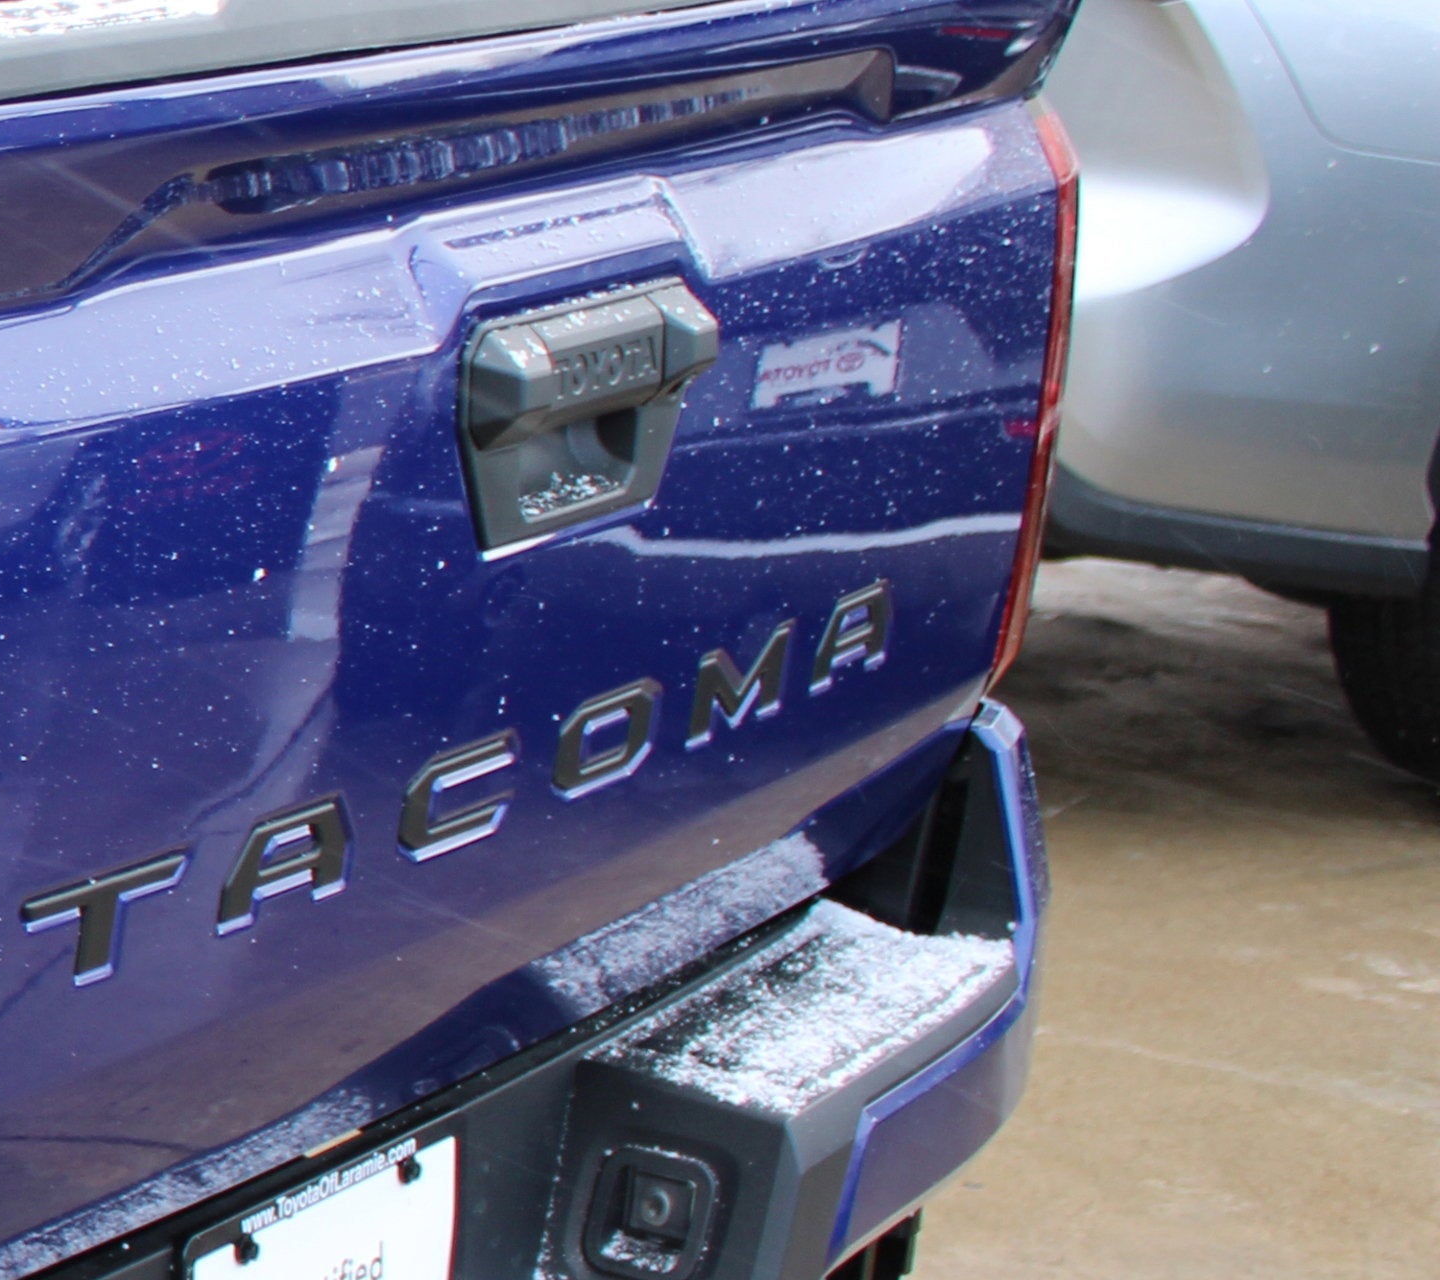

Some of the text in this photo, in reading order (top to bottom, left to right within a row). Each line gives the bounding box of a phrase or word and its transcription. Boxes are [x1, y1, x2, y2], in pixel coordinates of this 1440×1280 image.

[555, 335, 658, 400] TOYOTA
[20, 578, 894, 987] TACOMA
[241, 1138, 418, 1234] www.ToyotaOfLaramie.com
